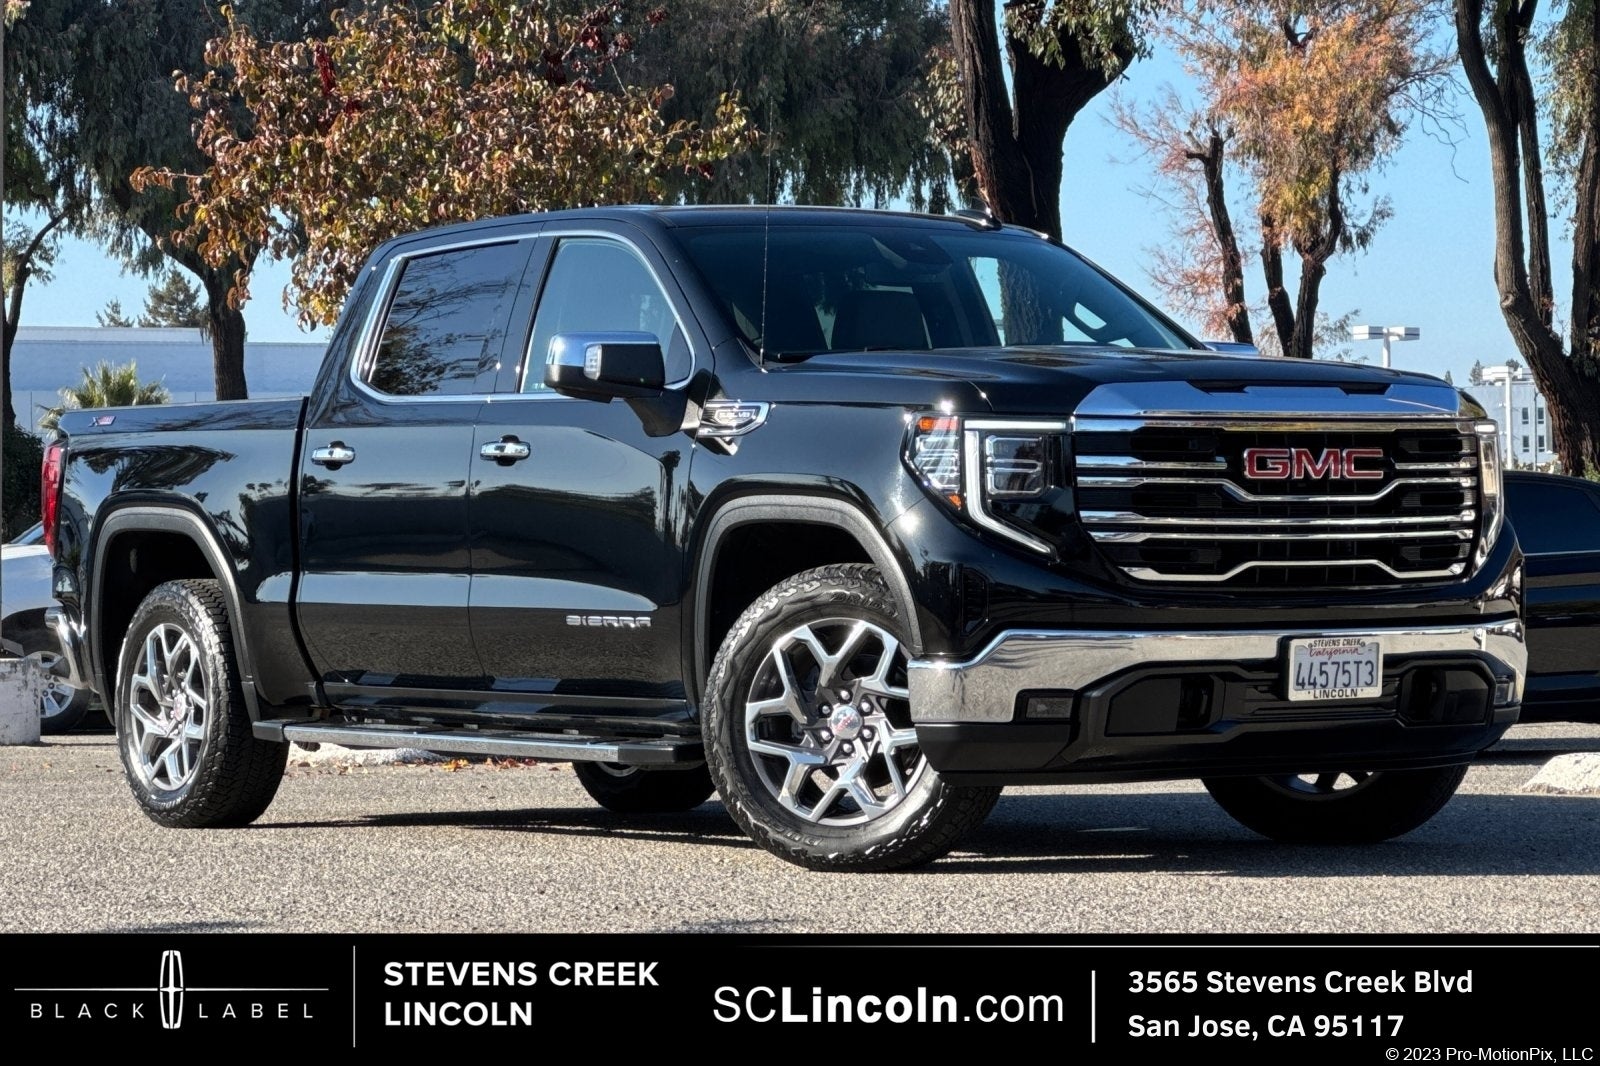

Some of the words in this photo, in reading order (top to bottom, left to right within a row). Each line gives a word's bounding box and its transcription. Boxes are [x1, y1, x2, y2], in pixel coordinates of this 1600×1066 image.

[1243, 447, 1384, 480] GMC
[565, 615, 652, 628] SIERRA
[1313, 639, 1341, 648] STEVENS
[1342, 638, 1362, 647] CREEK
[1309, 646, 1364, 661] California
[1295, 660, 1375, 690] 44575T3
[1313, 688, 1358, 699] LINCOLN
